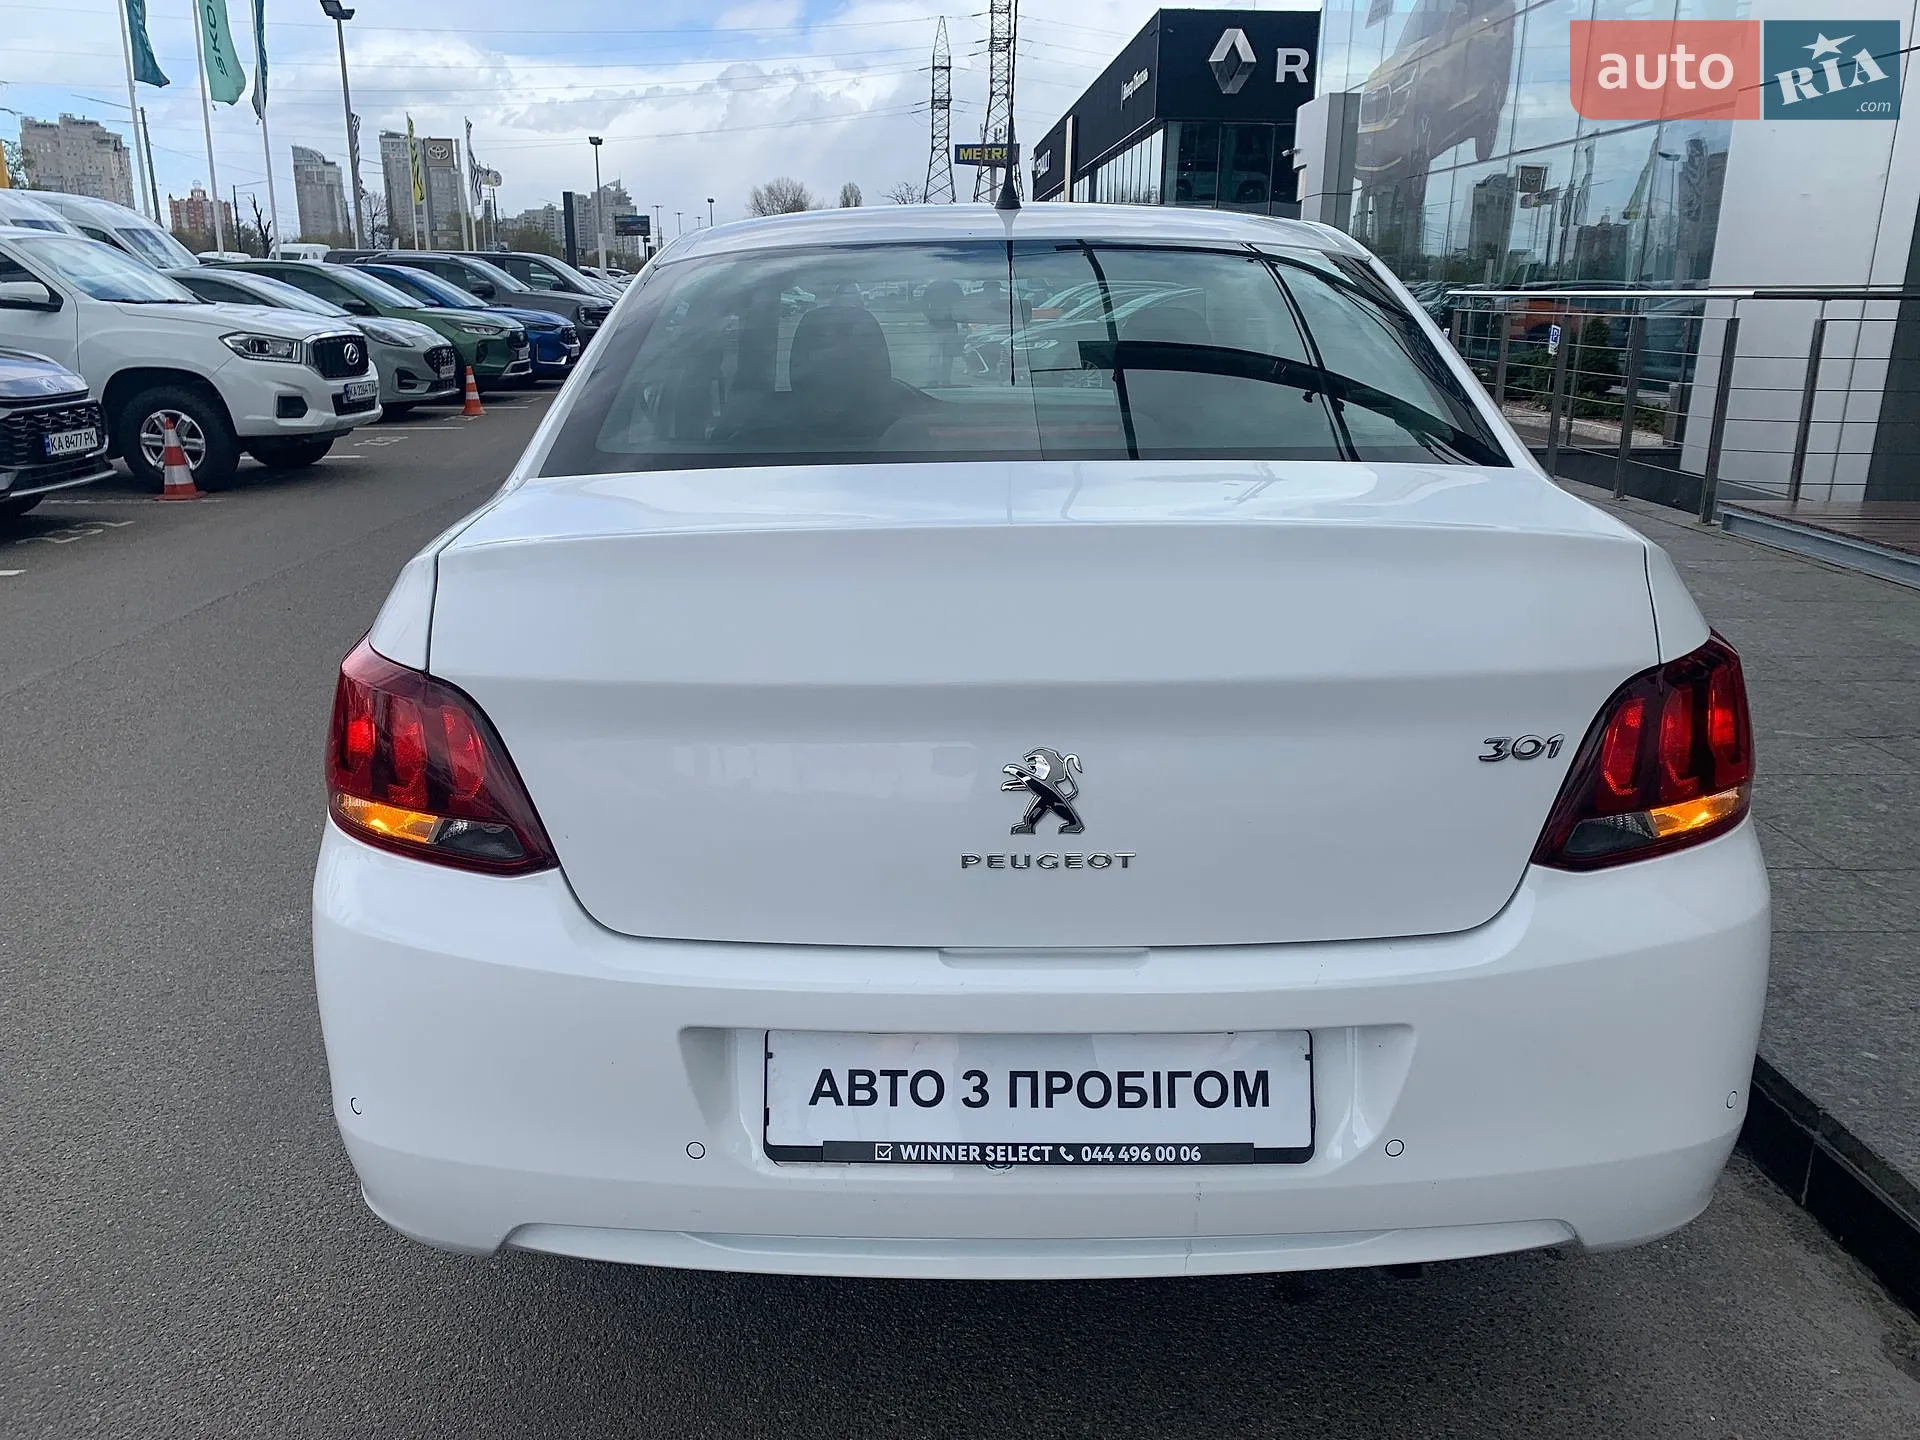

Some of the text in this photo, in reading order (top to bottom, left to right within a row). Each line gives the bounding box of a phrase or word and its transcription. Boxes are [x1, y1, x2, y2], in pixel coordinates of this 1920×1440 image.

[206, 0, 228, 77] SKO
[64, 432, 82, 449] 8477
[1478, 733, 1565, 762] 301
[960, 852, 1137, 869] PEUGEOT
[808, 1068, 1269, 1109] АВТО З ПРОБІГОМ
[900, 1144, 1202, 1162] WINNER SELECT 044 496 00 06
